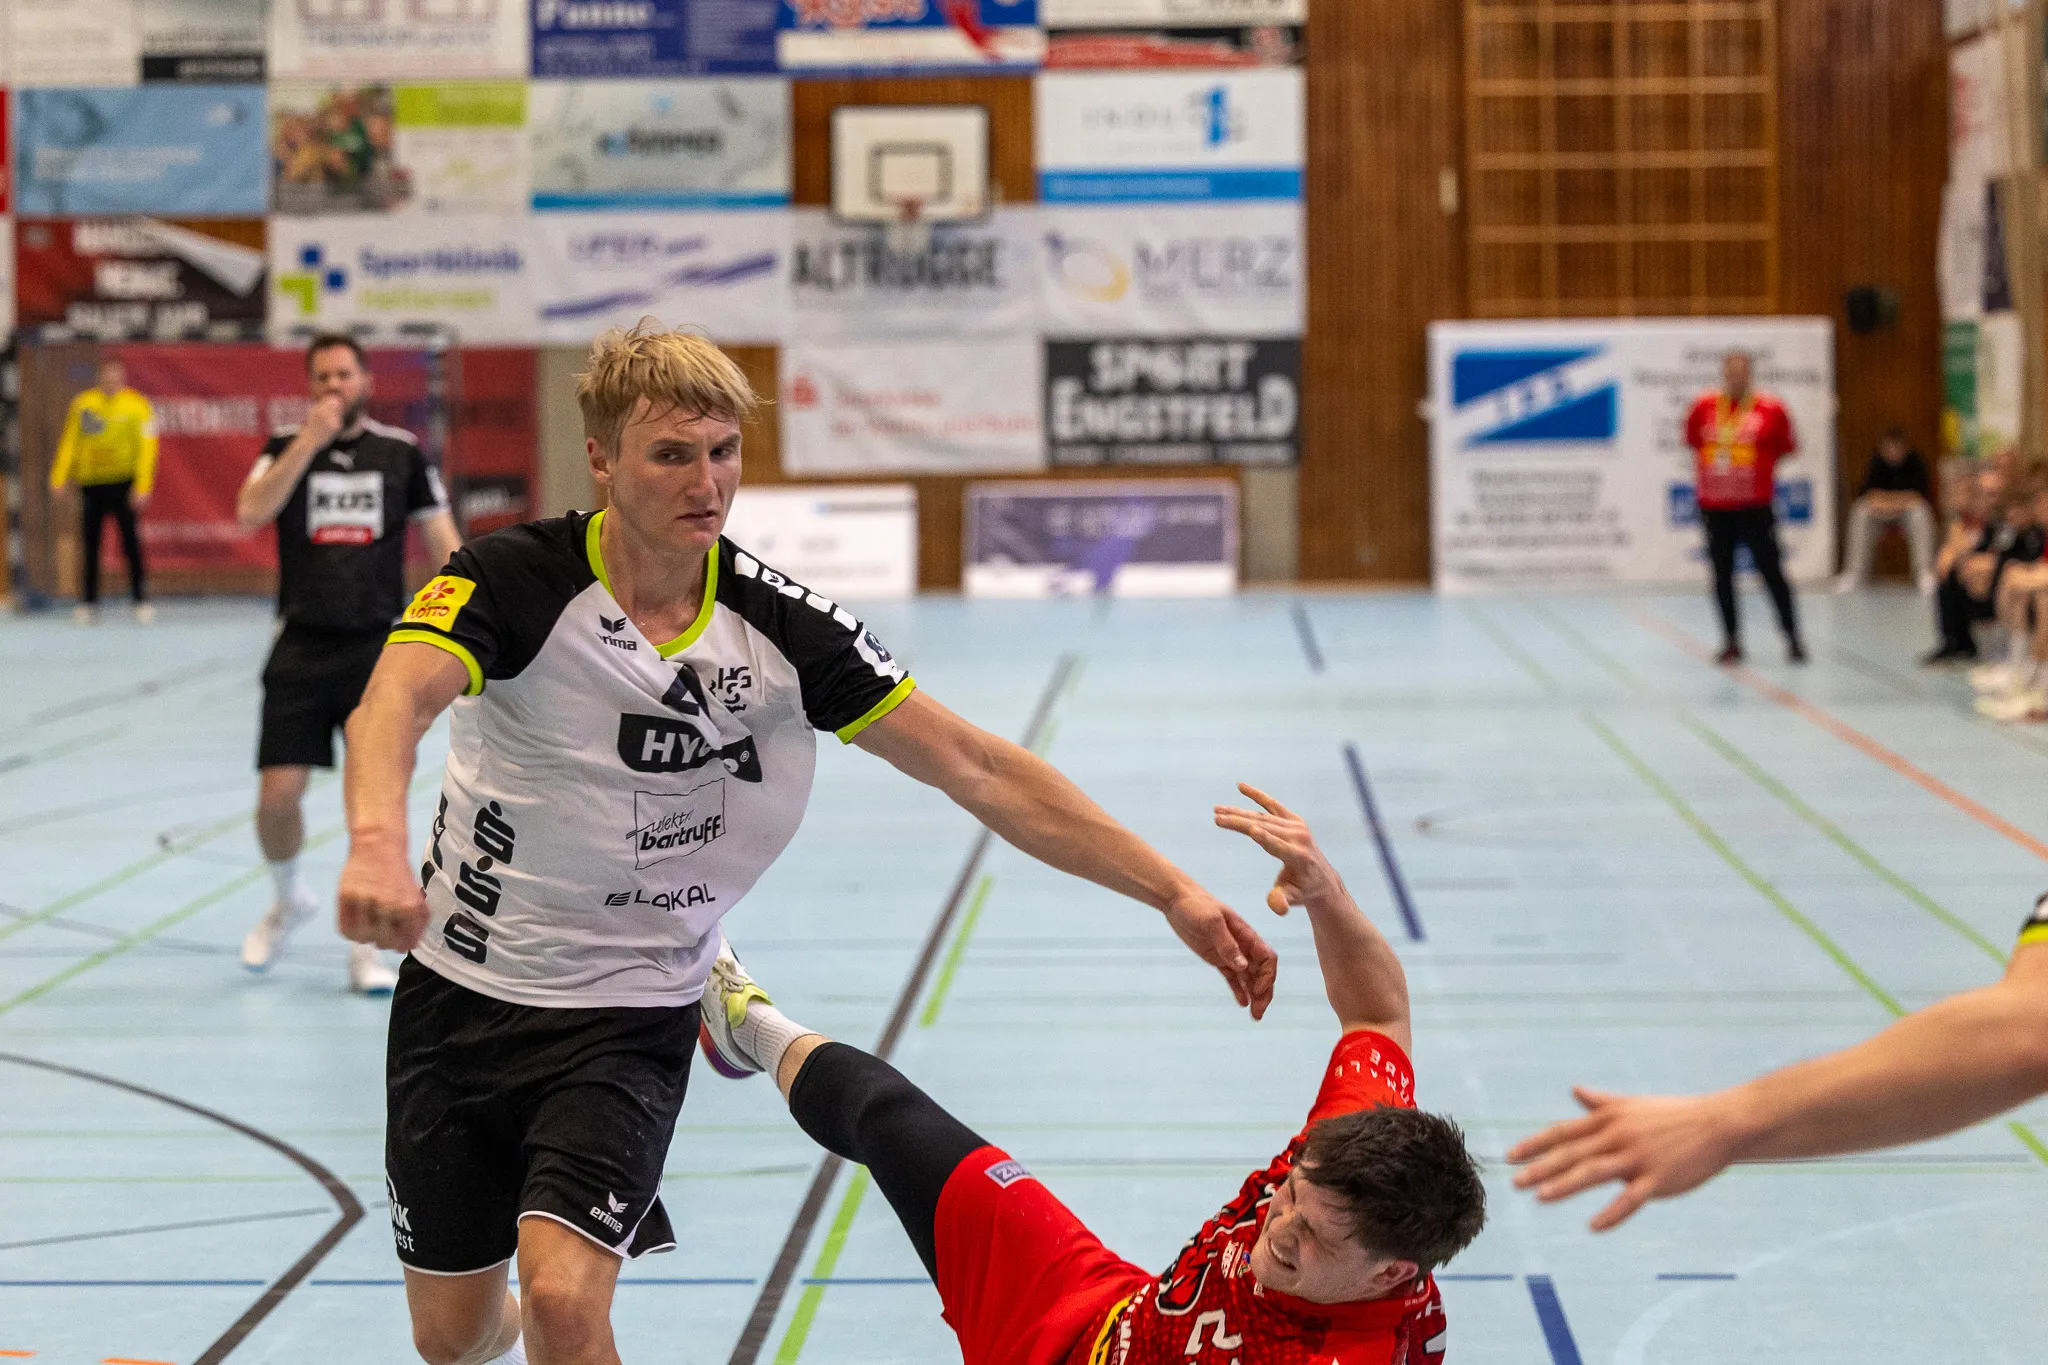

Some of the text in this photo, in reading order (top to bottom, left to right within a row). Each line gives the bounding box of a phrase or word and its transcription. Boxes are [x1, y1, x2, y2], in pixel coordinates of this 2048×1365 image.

[1089, 342, 1257, 392] SPORT
[409, 605, 450, 618] LOTTO
[595, 633, 637, 651] rima
[640, 814, 721, 851] bartruff
[634, 883, 716, 911] LAKAL
[589, 1206, 624, 1234] erima
